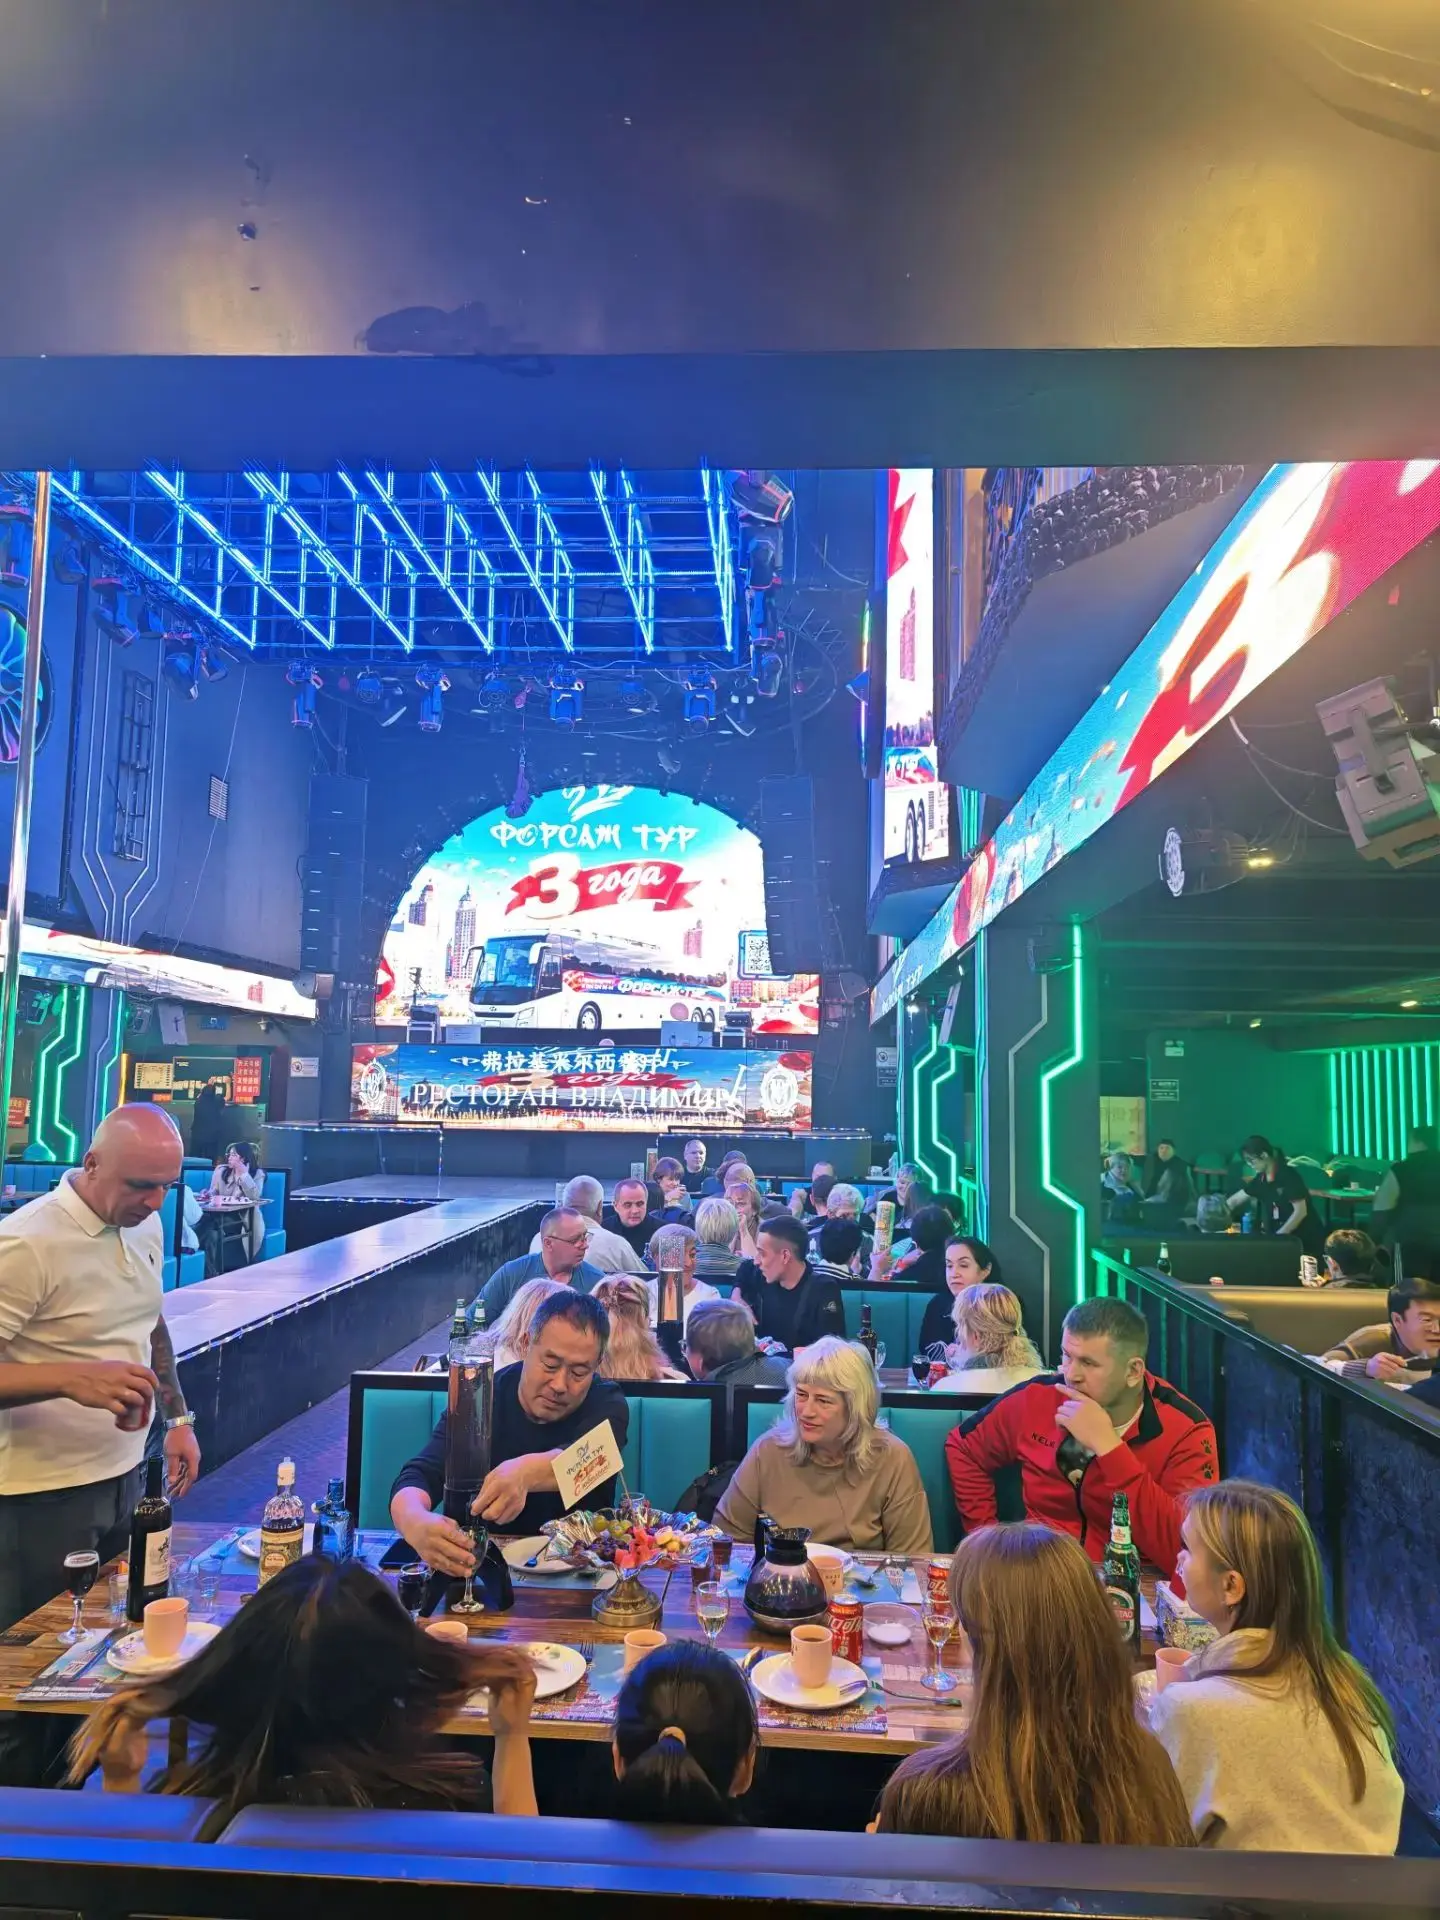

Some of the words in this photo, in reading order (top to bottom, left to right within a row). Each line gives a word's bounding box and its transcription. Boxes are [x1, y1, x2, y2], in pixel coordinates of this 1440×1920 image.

[632, 824, 699, 852] ТУР
[523, 852, 580, 920] 3
[587, 864, 666, 904] года
[411, 1083, 559, 1107] РЕСТОРАН
[571, 1085, 730, 1110] ВЛАДИМИР
